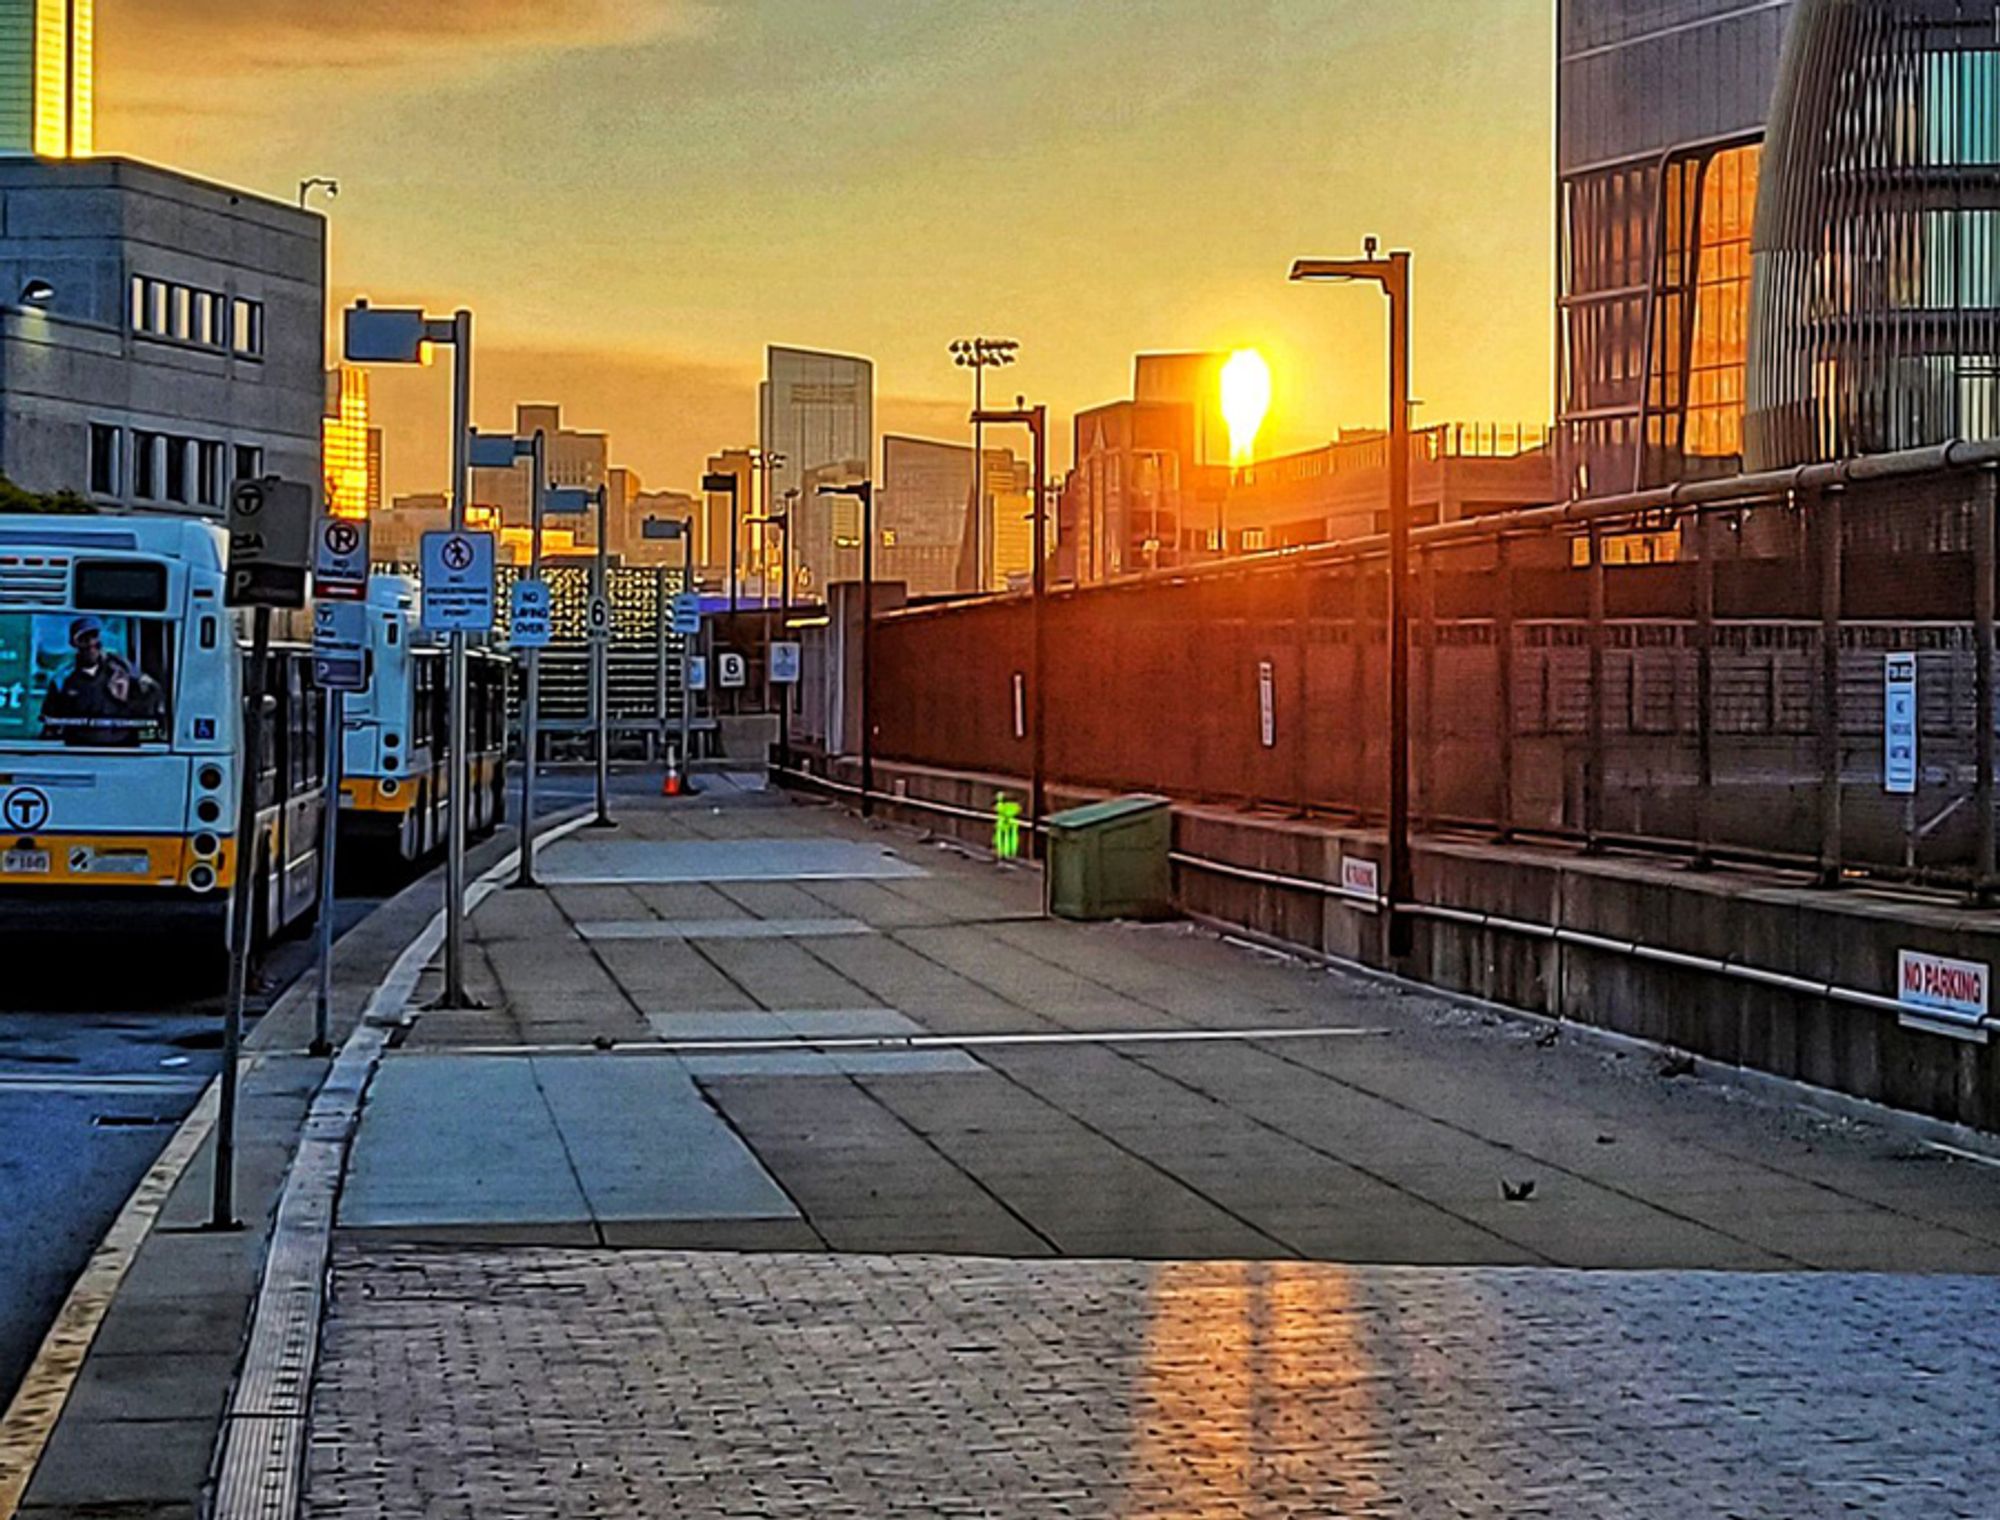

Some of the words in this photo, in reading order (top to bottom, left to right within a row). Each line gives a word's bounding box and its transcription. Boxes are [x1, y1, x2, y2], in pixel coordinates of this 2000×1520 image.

[522, 591, 539, 603] NO
[592, 599, 605, 627] 6
[514, 620, 545, 634] OVER
[725, 657, 739, 675] 6
[1904, 960, 1921, 993] NO
[1924, 963, 1982, 1005] PARKING
